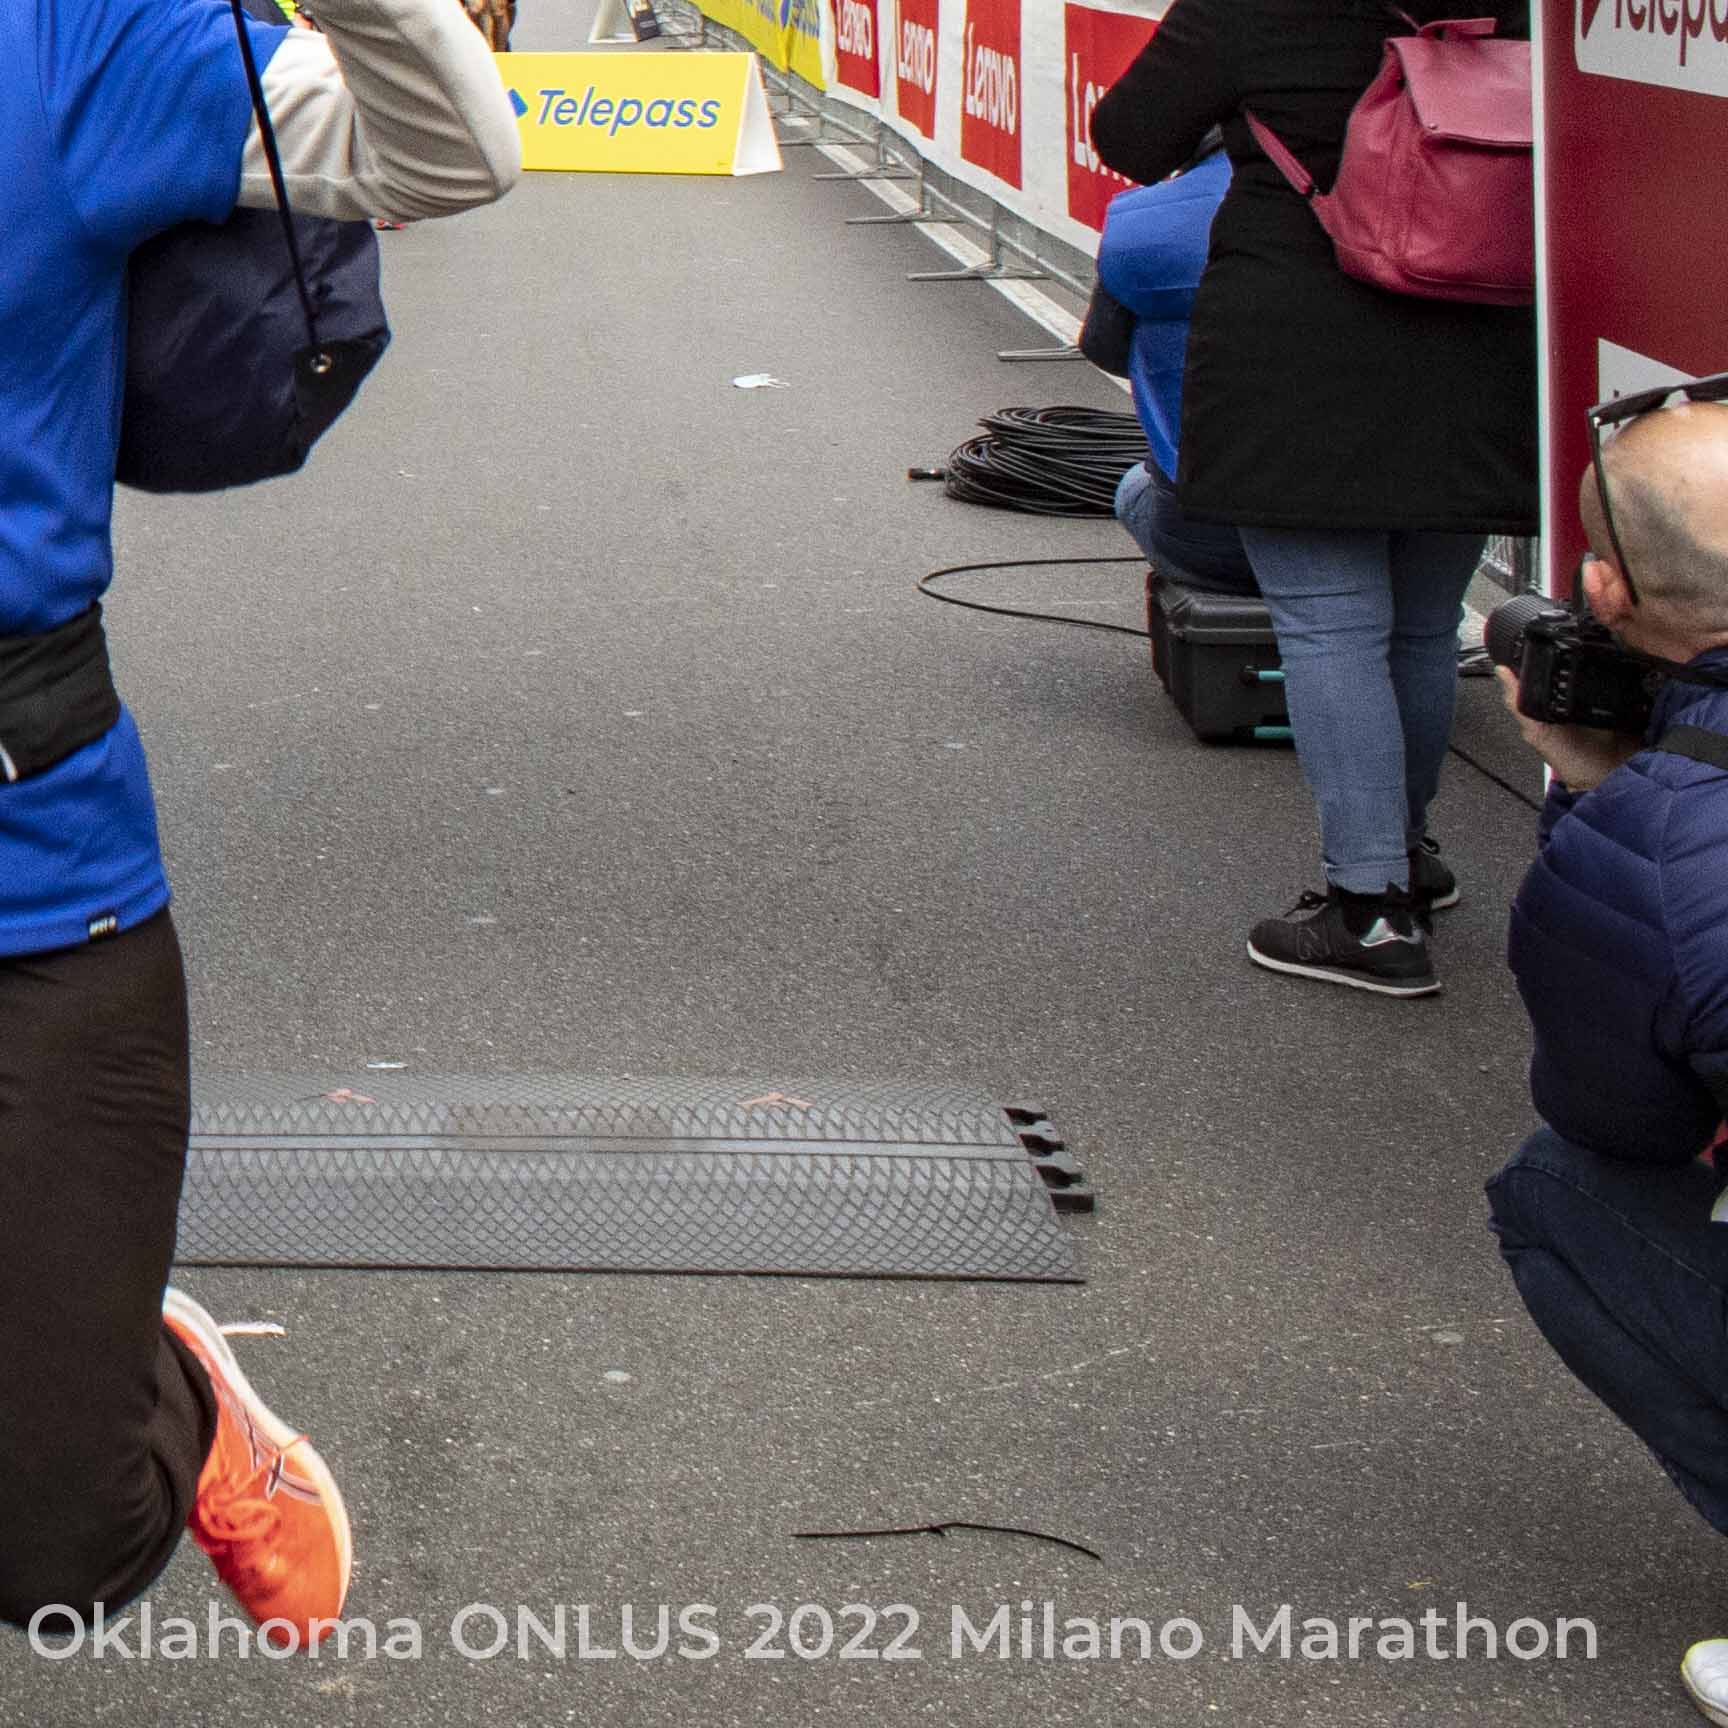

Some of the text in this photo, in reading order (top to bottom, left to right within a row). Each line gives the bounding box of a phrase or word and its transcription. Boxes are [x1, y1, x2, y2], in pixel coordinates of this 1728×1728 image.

[537, 86, 722, 137] Telepass
[895, 0, 934, 95] Lenovo
[966, 22, 1017, 135] Lenovo
